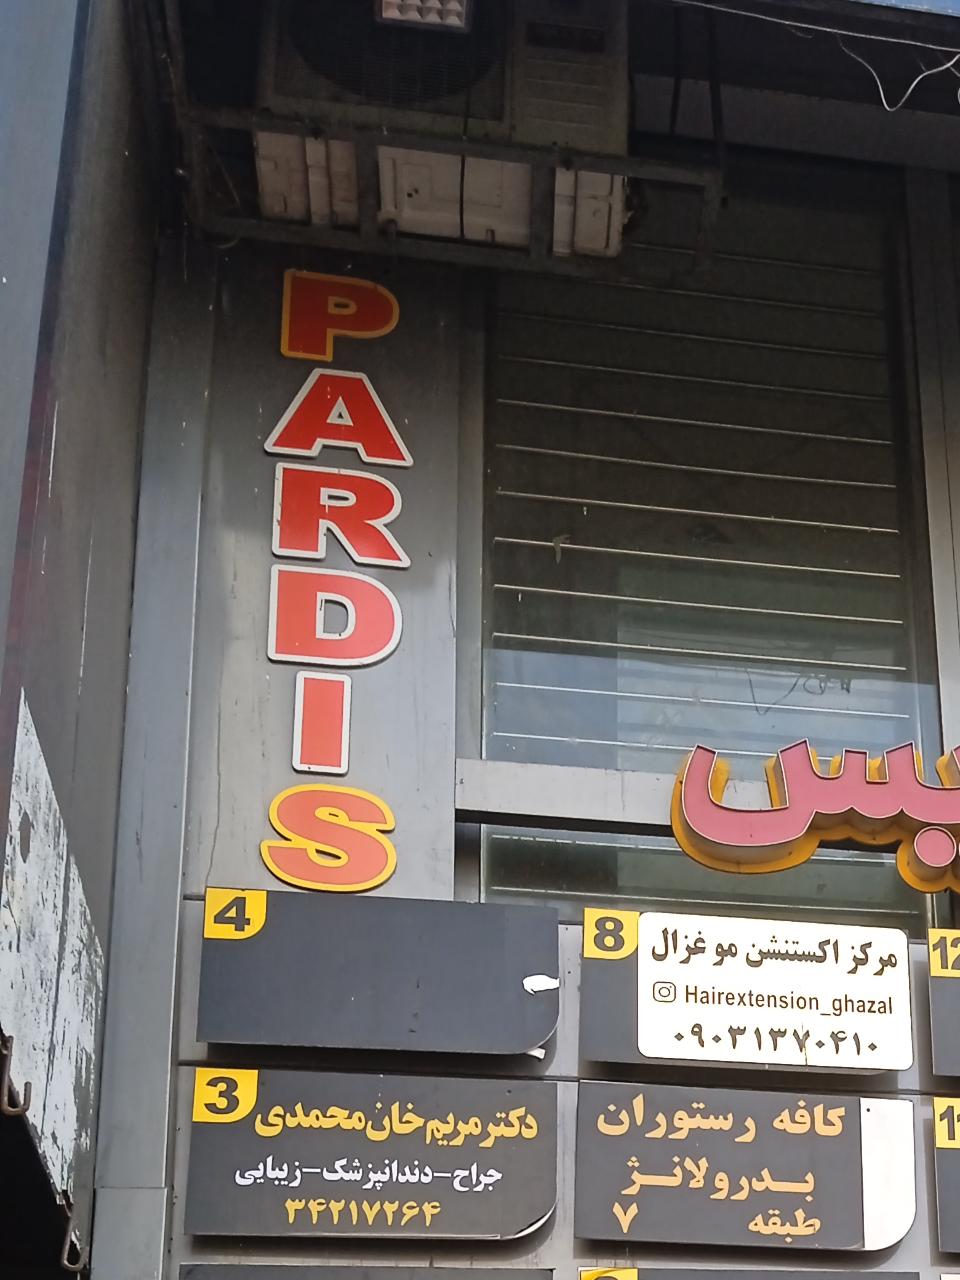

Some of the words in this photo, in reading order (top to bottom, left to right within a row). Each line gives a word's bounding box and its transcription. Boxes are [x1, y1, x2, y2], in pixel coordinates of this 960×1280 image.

[260, 268, 413, 893] PARDIS
[213, 896, 251, 932] 4
[593, 915, 625, 953] 8
[651, 927, 707, 965] غزال
[746, 935, 840, 968] اکستنشن
[712, 939, 738, 967] مو
[847, 941, 898, 976] مرکز
[685, 985, 893, 1017] Hairextension_ghazal
[674, 1022, 878, 1056] ۰۹۰۳۱۳۷۰۴۱۰
[204, 1076, 240, 1115] 3
[425, 1114, 482, 1147] مریم
[479, 1107, 539, 1148] دکتر
[597, 1093, 757, 1143] رستوران
[772, 1099, 846, 1137] کافه
[285, 1197, 442, 1228] ۳۴۲۱۷۲۶۴
[612, 1202, 640, 1234] ۷
[748, 1208, 822, 1243] طبقه
